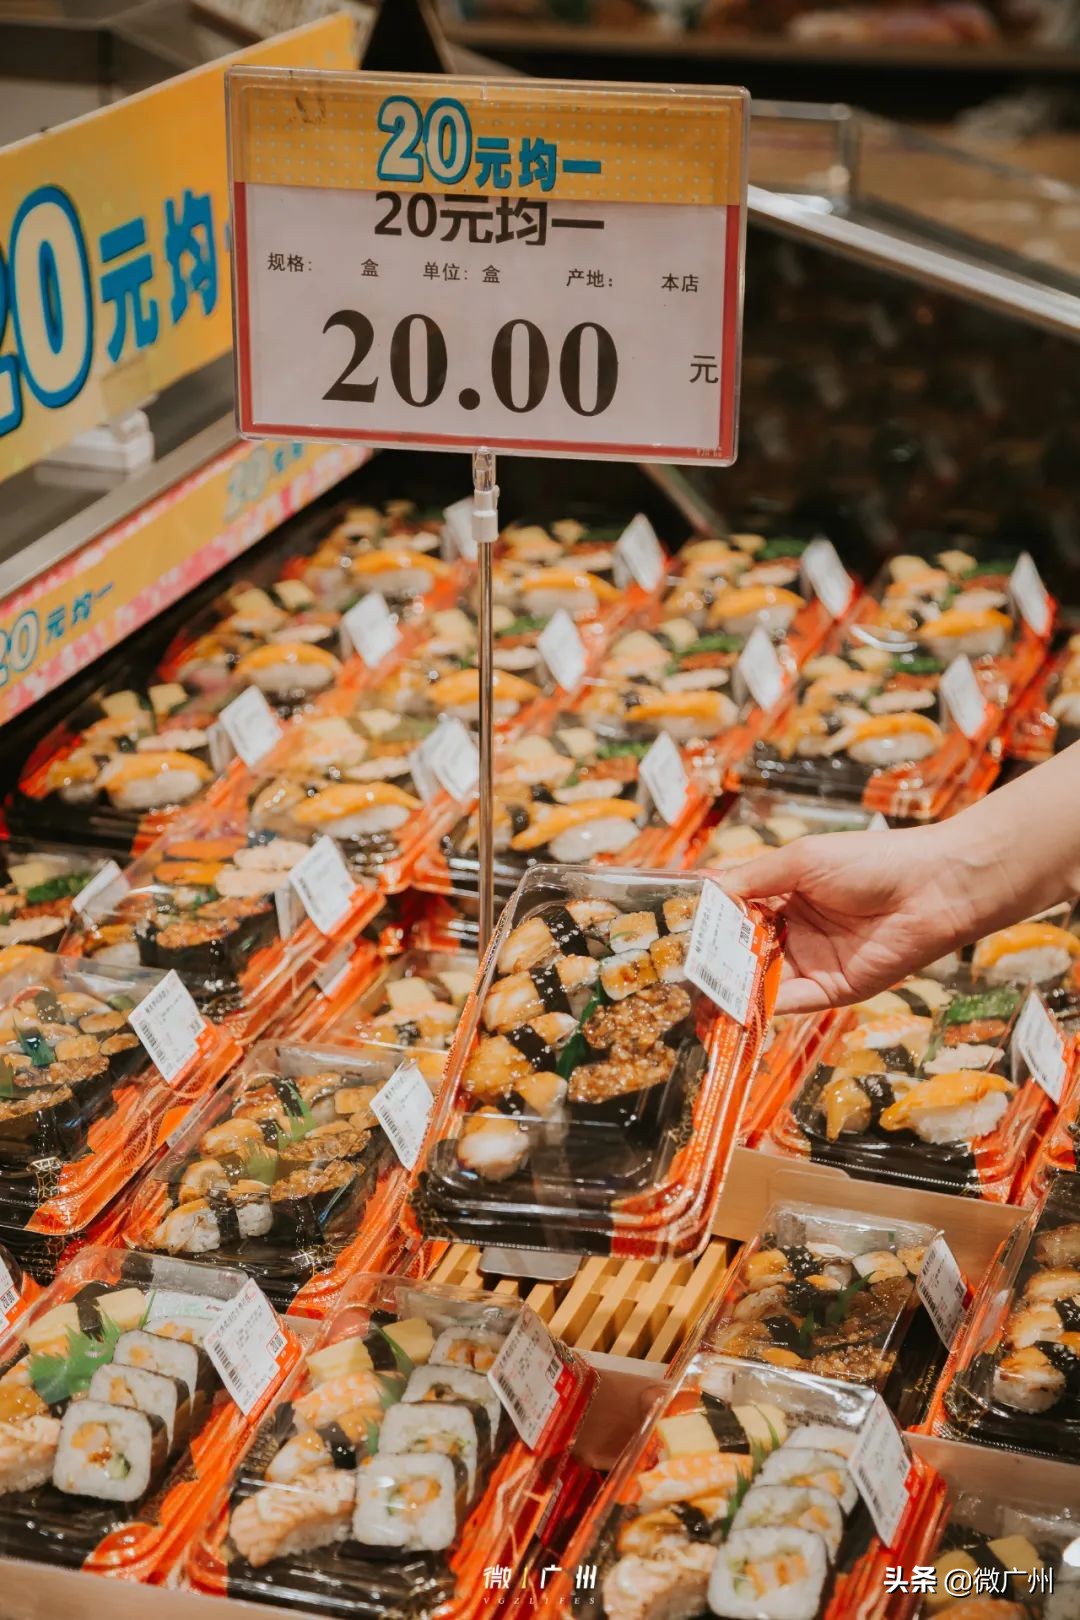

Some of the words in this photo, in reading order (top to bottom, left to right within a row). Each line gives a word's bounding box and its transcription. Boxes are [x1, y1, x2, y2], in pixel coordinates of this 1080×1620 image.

[376, 95, 603, 191] 20元均一
[374, 191, 605, 247] 20元均一
[0, 184, 230, 437] 0元均
[267, 252, 313, 273] 规格：
[361, 258, 379, 277] 盒
[566, 268, 613, 288] 产地：
[661, 273, 700, 293] 本店
[321, 309, 619, 417] 20.00
[689, 355, 719, 384] 元
